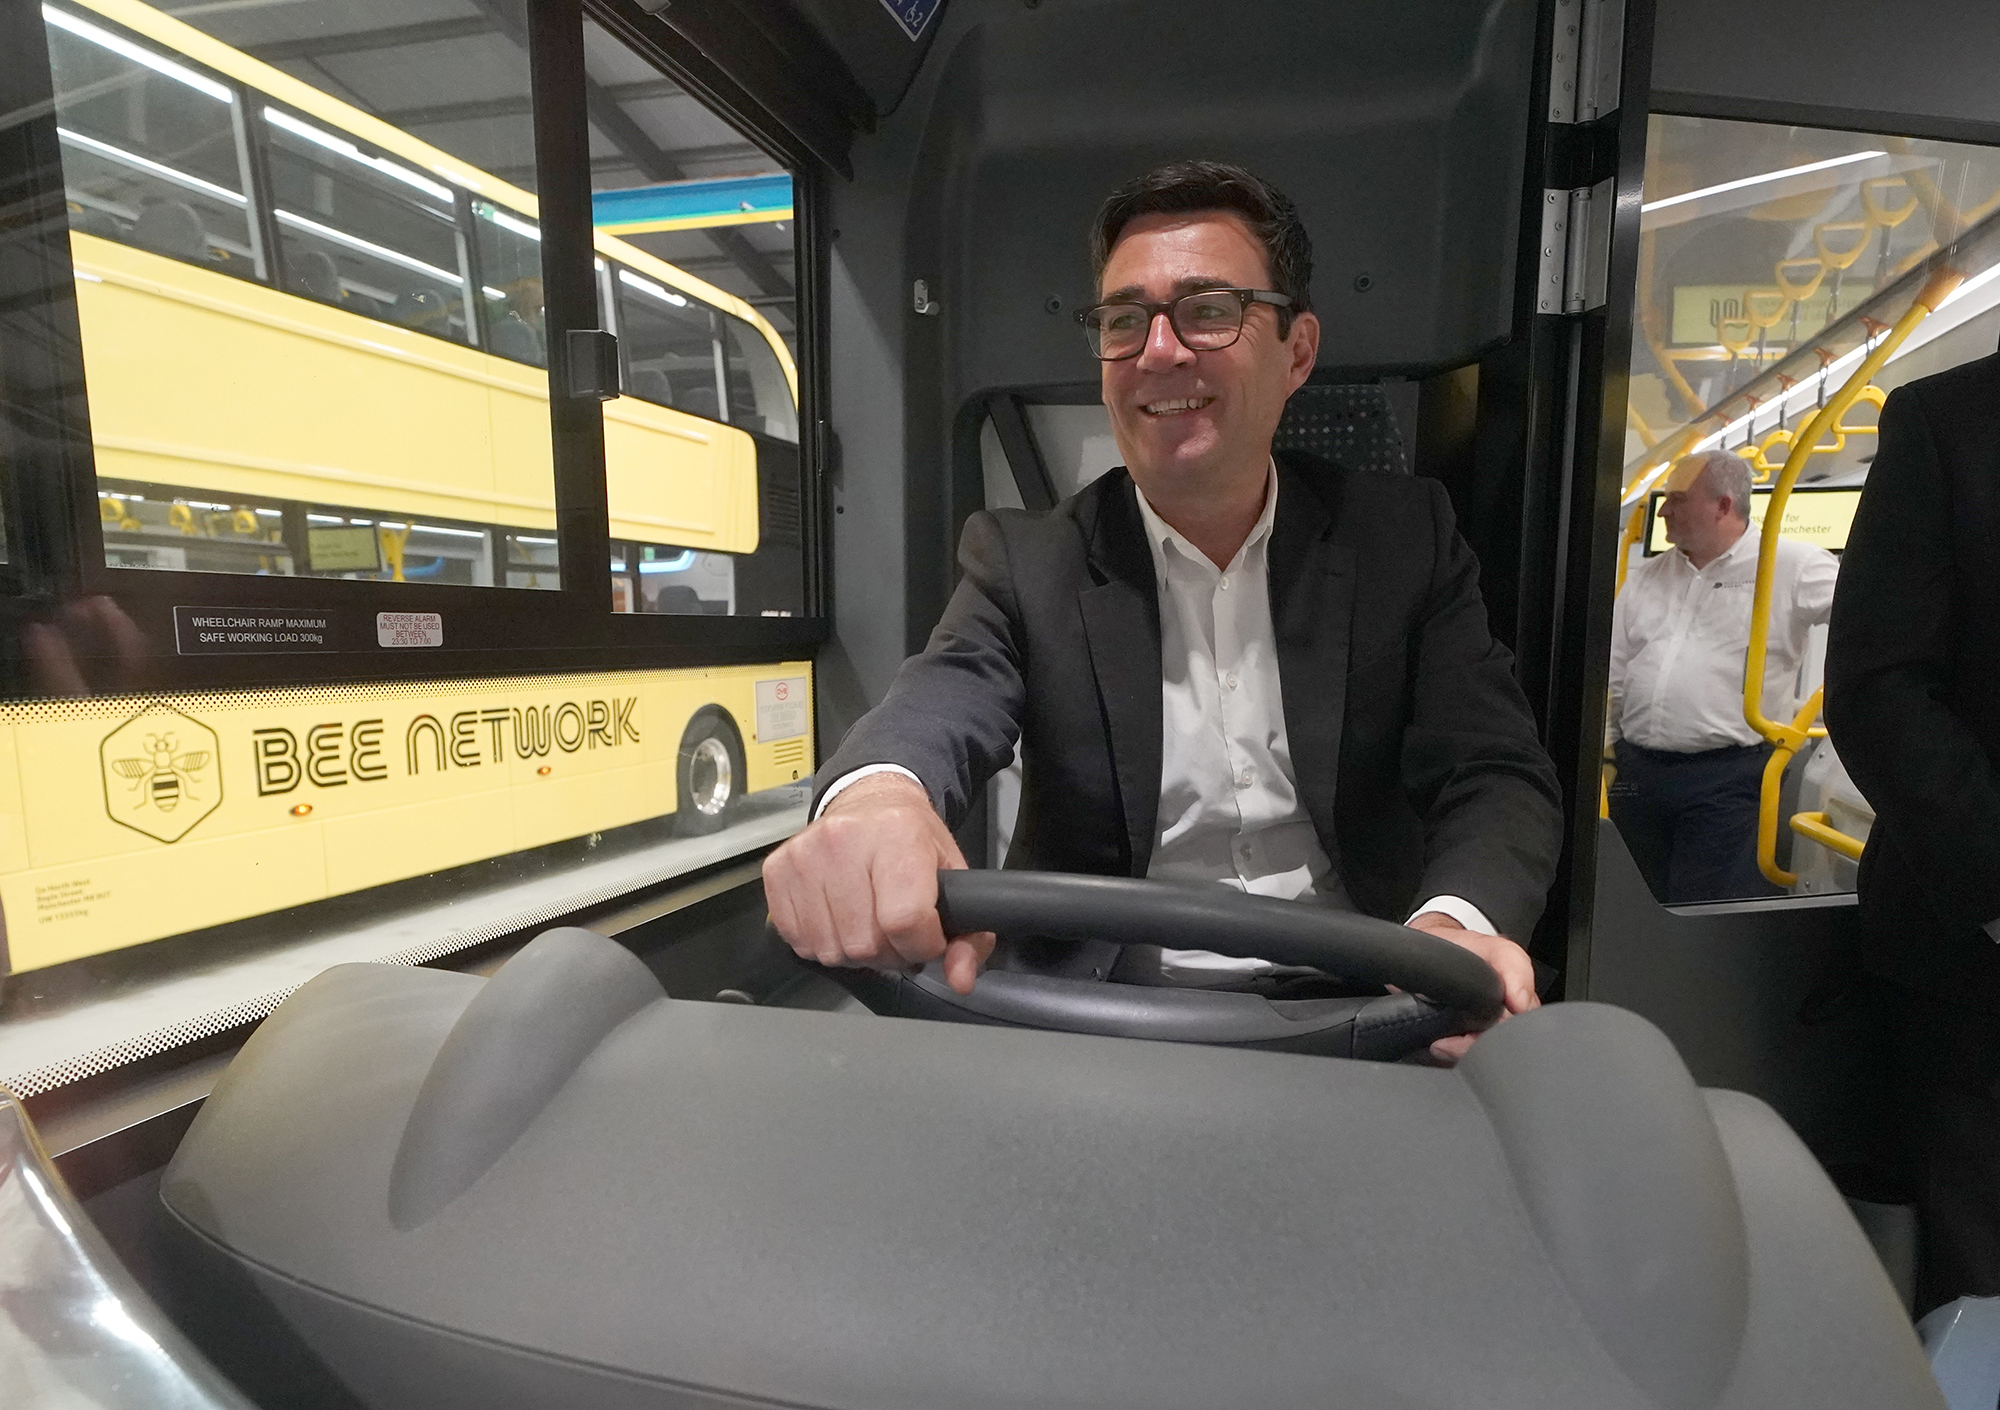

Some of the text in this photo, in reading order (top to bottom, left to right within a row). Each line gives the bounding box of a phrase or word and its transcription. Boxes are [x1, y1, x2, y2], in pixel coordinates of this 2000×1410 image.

[1785, 513, 1800, 522] for
[1780, 525, 1831, 534] anchester
[192, 617, 326, 628] WHEELCHAIR RAMP MAXIMUM
[383, 614, 414, 622] REVERSE
[380, 622, 398, 630] MUST
[200, 632, 323, 644] SAFE WORKING LOAD 300kg
[396, 630, 427, 638] BETWEEN
[252, 697, 640, 797] BEE NETWORK
